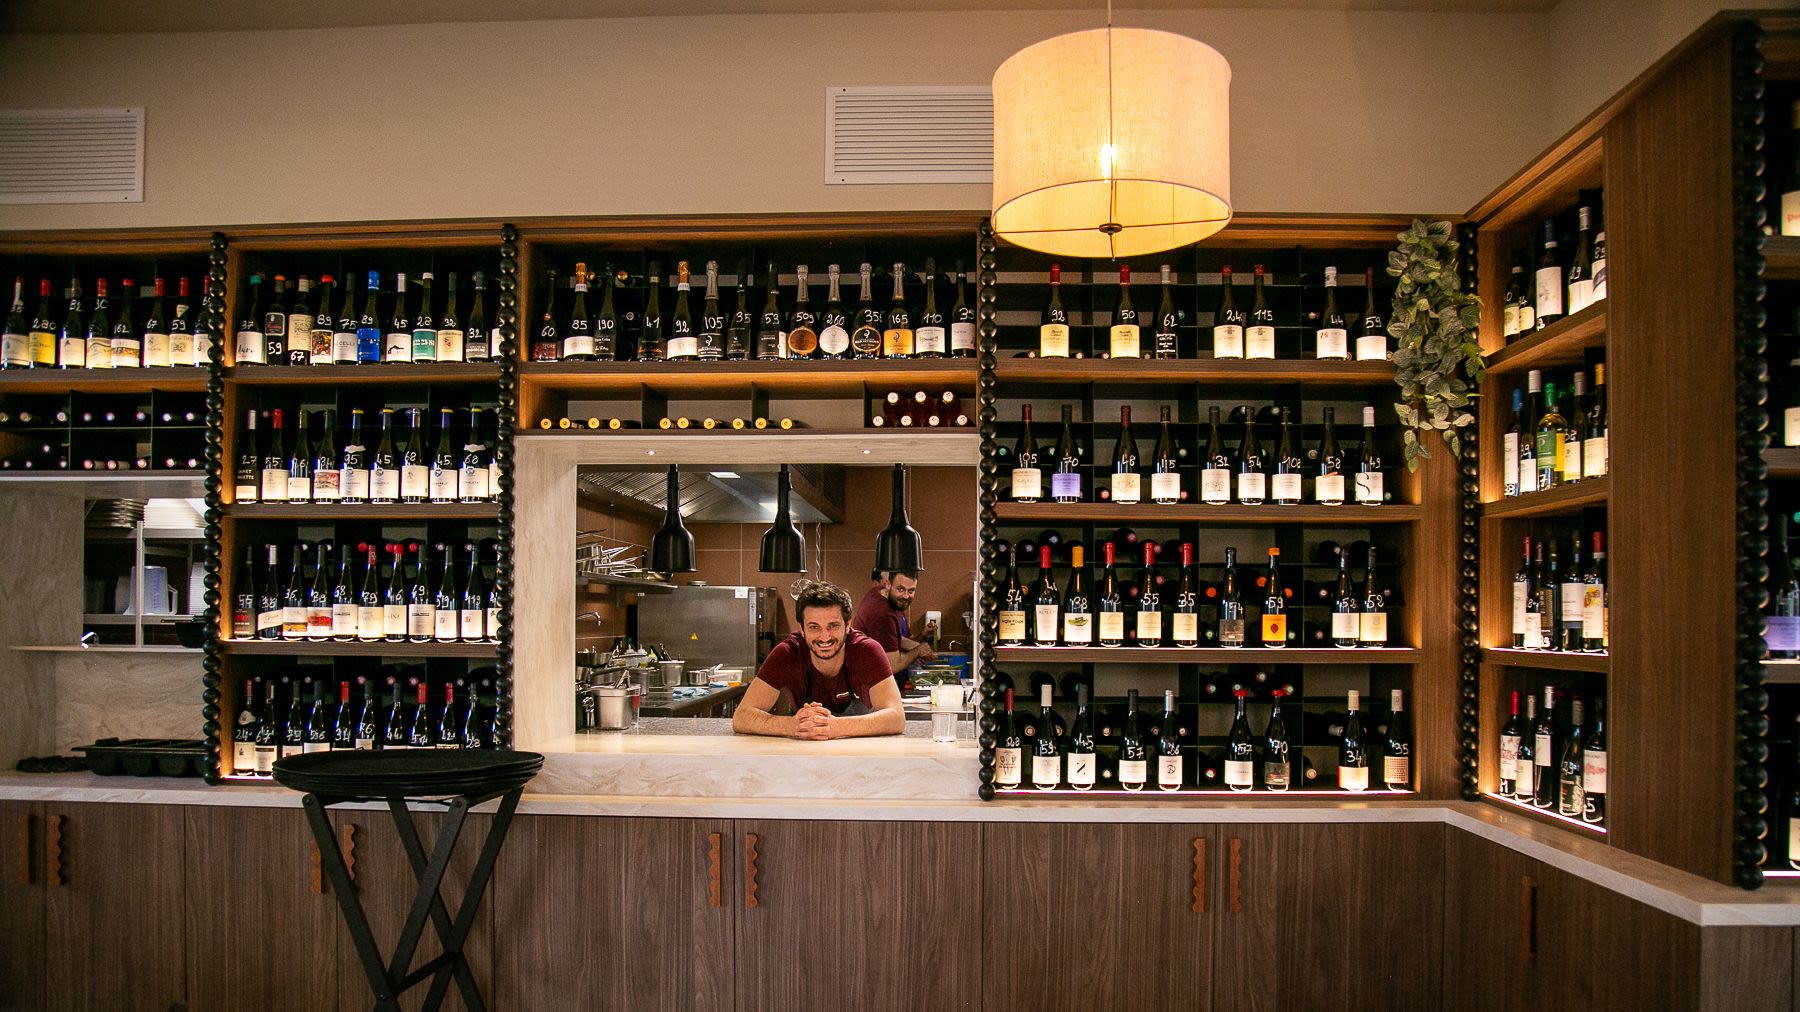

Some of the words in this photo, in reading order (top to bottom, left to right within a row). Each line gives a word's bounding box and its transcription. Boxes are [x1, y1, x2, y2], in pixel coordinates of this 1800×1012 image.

[317, 314, 332, 326] 89
[735, 311, 752, 324] 35
[764, 312, 780, 325] 53
[826, 314, 845, 326] 260
[891, 312, 908, 324] 165
[923, 312, 943, 324] 110
[1051, 309, 1066, 322] 92
[1121, 309, 1136, 320] 50
[1163, 313, 1178, 327] 62
[1254, 309, 1273, 321] 115
[147, 319, 158, 329] 67
[171, 320, 186, 330] 59
[393, 318, 408, 329] 45
[571, 319, 588, 330] 85
[645, 316, 660, 329] 41
[675, 320, 690, 333] 92
[704, 316, 724, 330] 105
[1365, 316, 1382, 329] 59
[114, 324, 129, 334] 162
[469, 328, 482, 338] 32
[541, 325, 555, 337] 60
[268, 342, 283, 355] 59
[290, 351, 305, 361] 67
[464, 454, 479, 464] 68
[1018, 452, 1038, 464] 105
[1062, 456, 1079, 467] 70
[1215, 455, 1229, 467] 32
[1248, 456, 1262, 469] 54
[1369, 456, 1381, 469] 49
[1143, 592, 1160, 606] 55
[1346, 750, 1362, 763] 34
